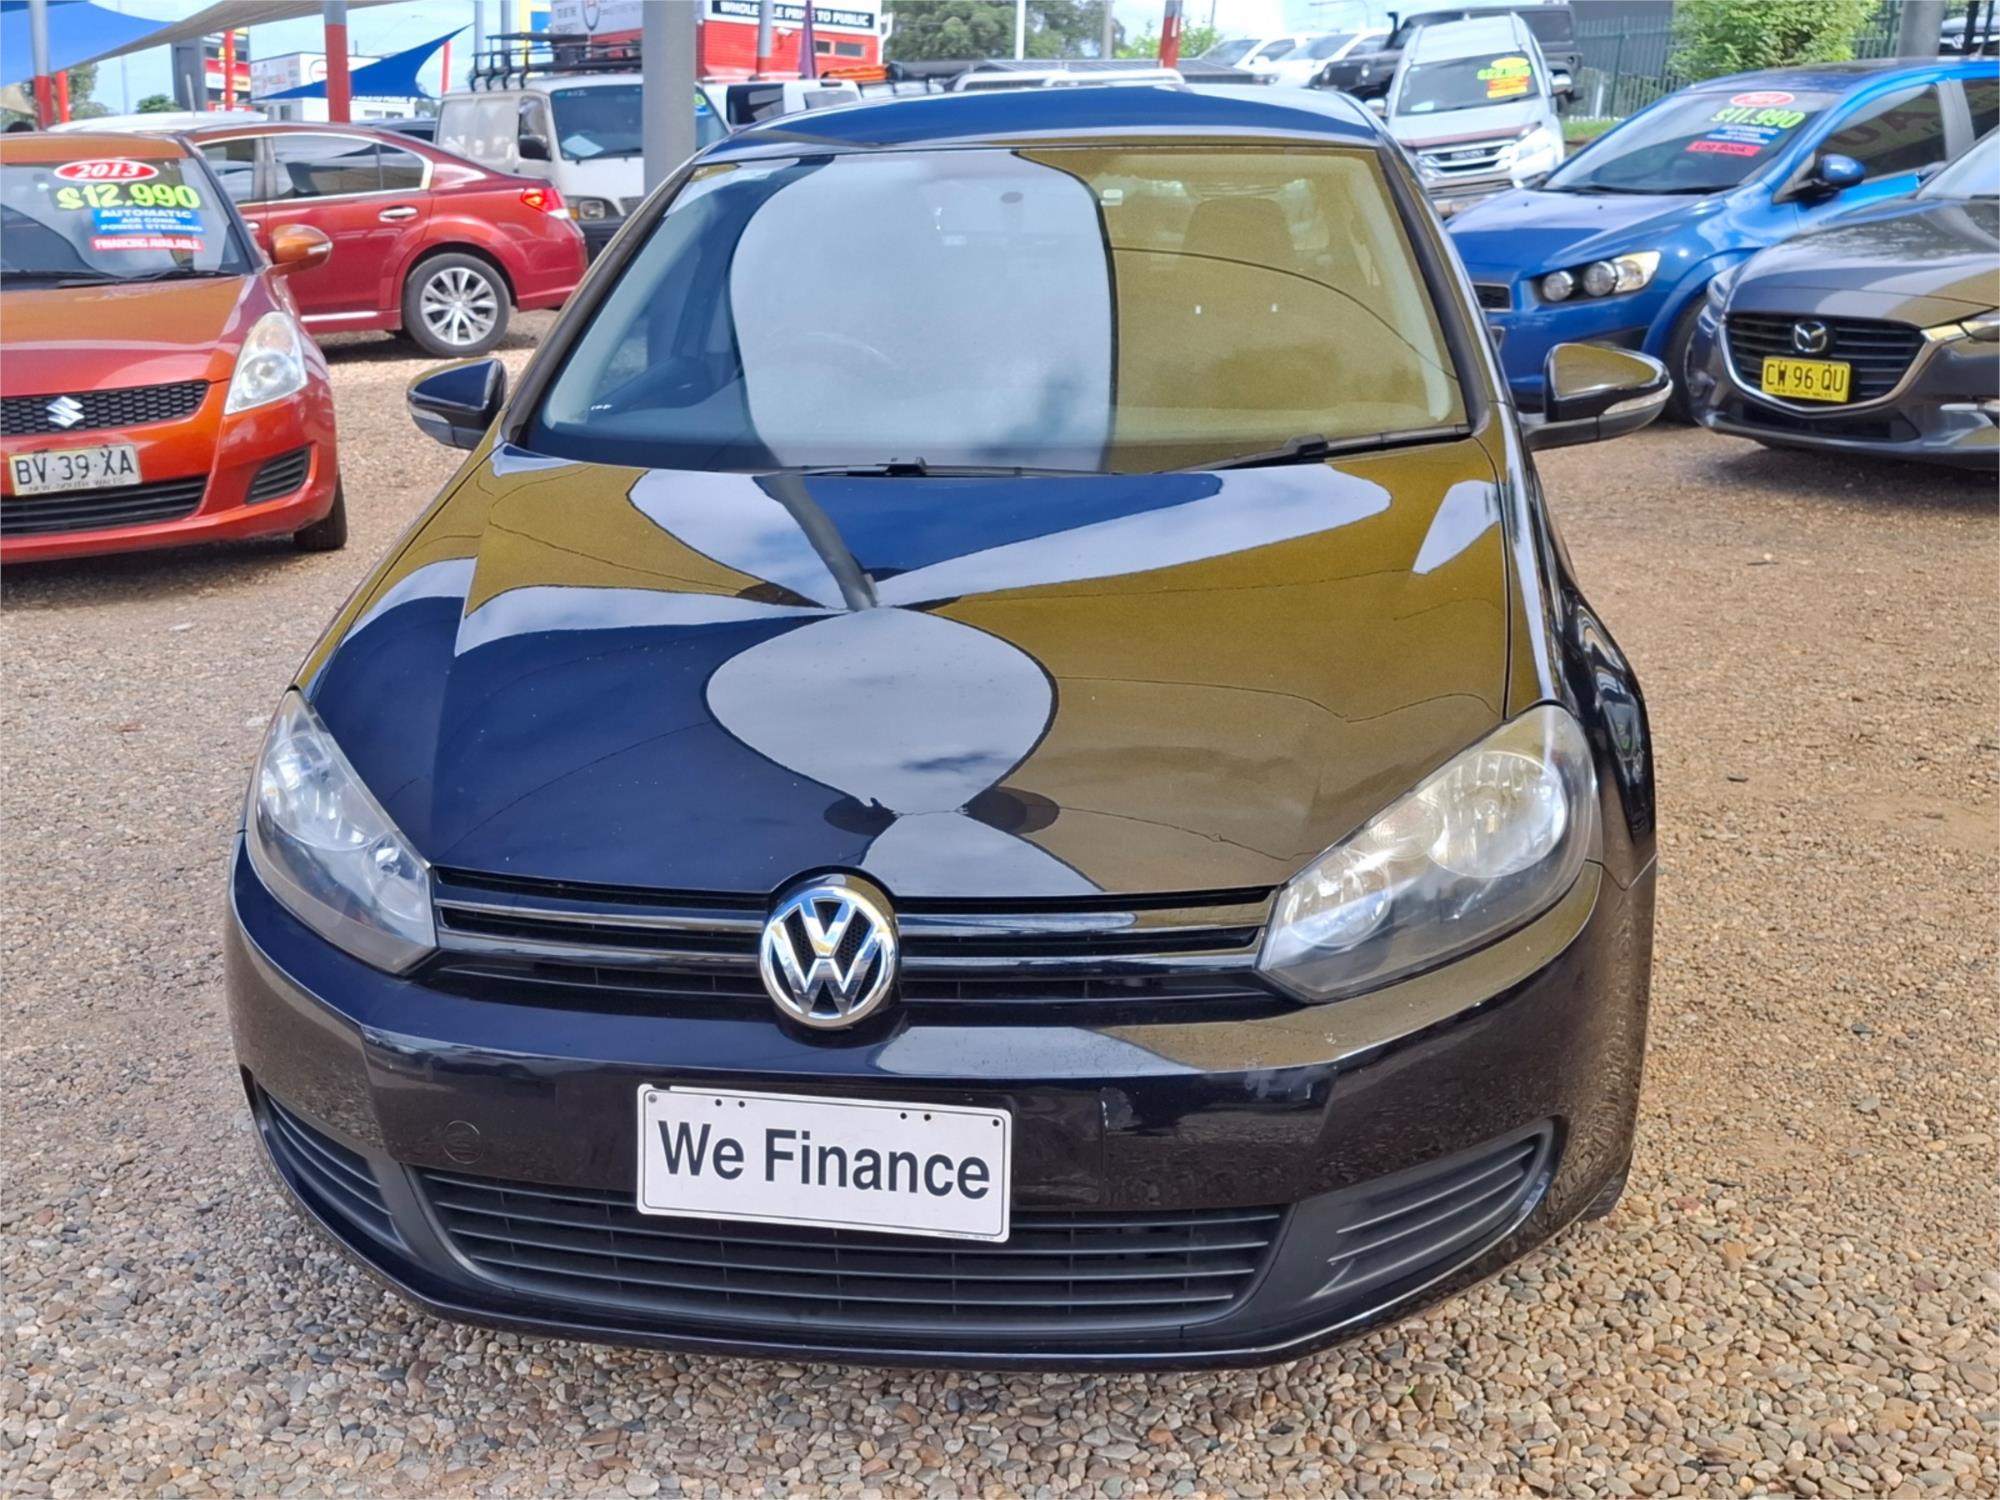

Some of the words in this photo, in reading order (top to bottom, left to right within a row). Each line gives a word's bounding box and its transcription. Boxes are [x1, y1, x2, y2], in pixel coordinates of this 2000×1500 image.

[816, 11, 832, 22] TO
[832, 12, 870, 26] PUBLIC
[74, 163, 141, 179] 2013
[101, 208, 193, 218] AUTOMATIC
[145, 223, 203, 232] STEERING
[94, 237, 145, 249] FINANCING
[146, 237, 201, 250] AVAILABLE
[657, 1119, 745, 1180] We
[764, 1127, 991, 1200] Finance
